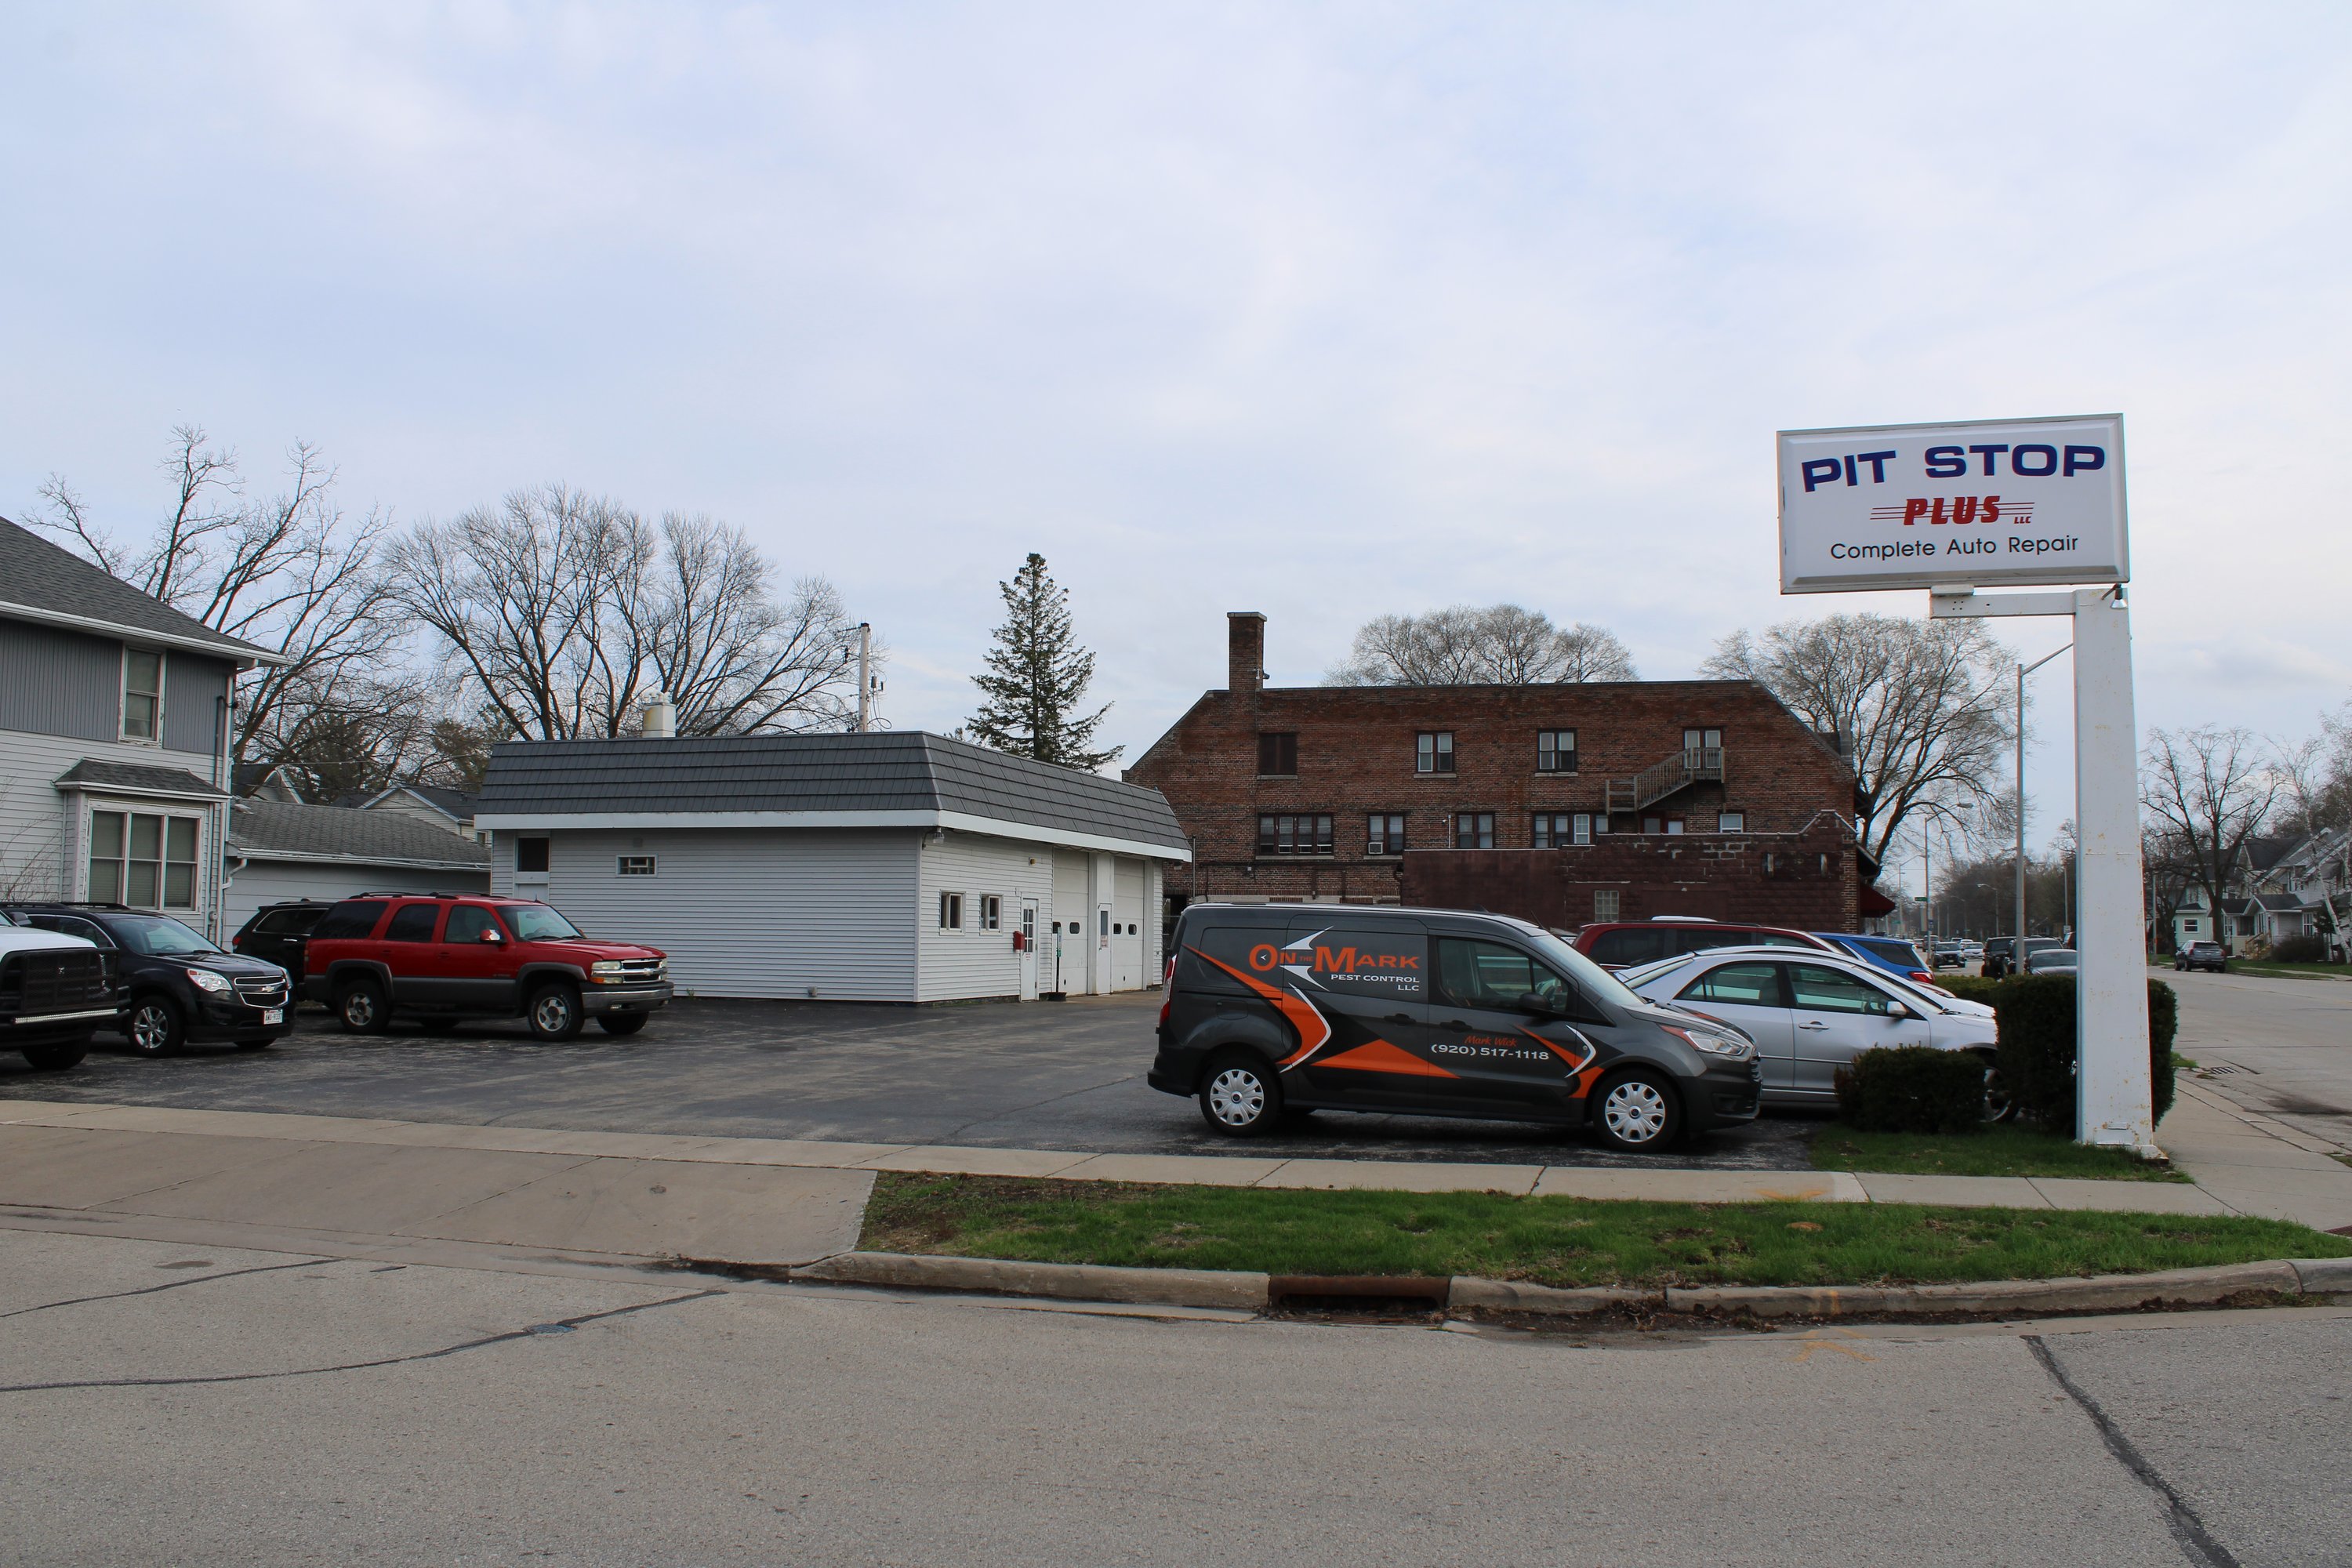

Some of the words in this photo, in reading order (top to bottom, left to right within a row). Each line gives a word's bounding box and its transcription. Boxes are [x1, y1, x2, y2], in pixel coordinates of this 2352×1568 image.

[1801, 449, 1896, 493] PIT
[1924, 444, 2106, 478] STOP
[1903, 495, 2001, 526] PLUS
[2013, 515, 2032, 524] LLC
[1830, 540, 1936, 561] Complete
[1946, 537, 1997, 555] Auto
[2008, 535, 2079, 556] Repair
[1363, 974, 1421, 983] CONTROL
[1464, 1035, 1492, 1046] Mark
[1494, 1036, 1518, 1047] Wick
[1430, 1044, 1477, 1057] (920)
[1479, 1047, 1550, 1061] 517-1118
